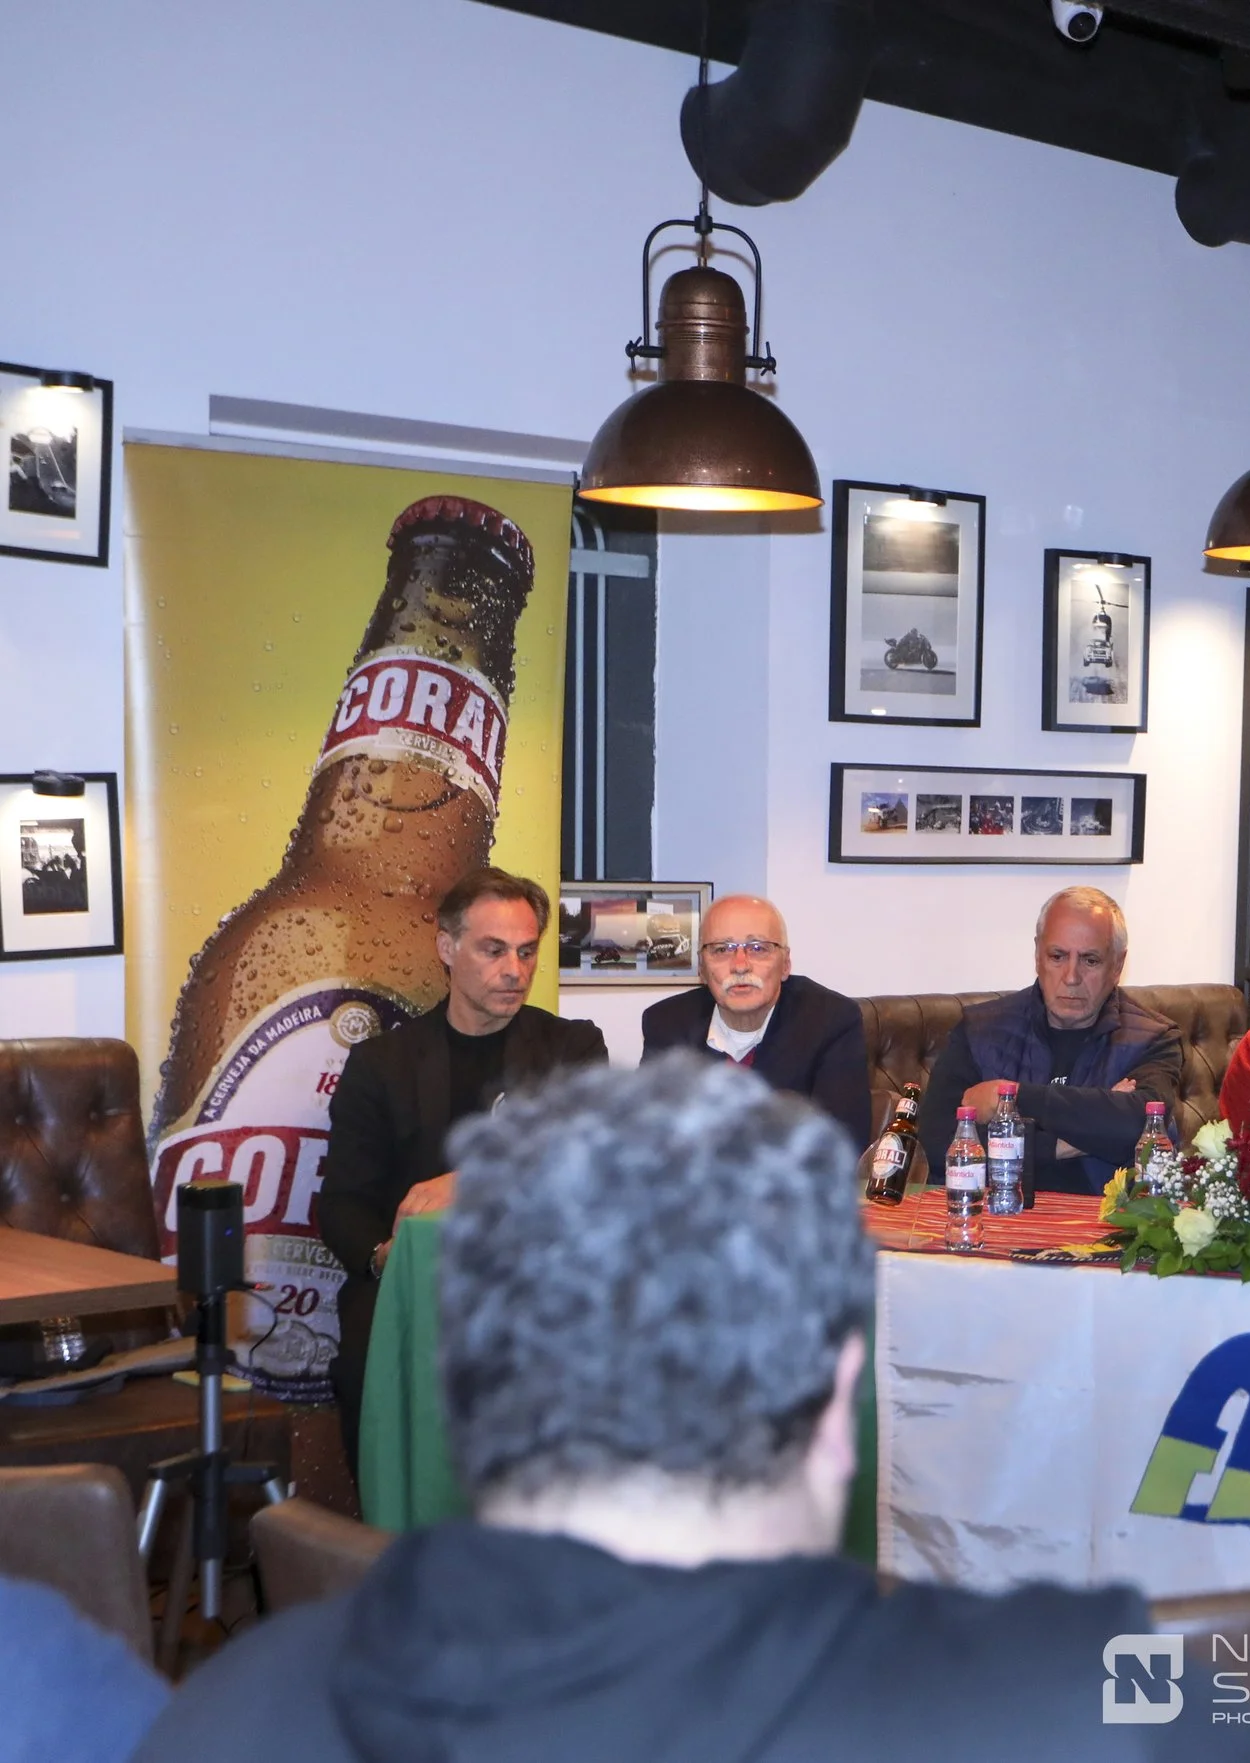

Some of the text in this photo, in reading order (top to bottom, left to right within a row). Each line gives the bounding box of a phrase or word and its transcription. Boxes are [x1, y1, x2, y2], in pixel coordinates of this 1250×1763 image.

[204, 1004, 323, 1119] A CERVEJA DA MADEIRA
[275, 1284, 320, 1317] 20
